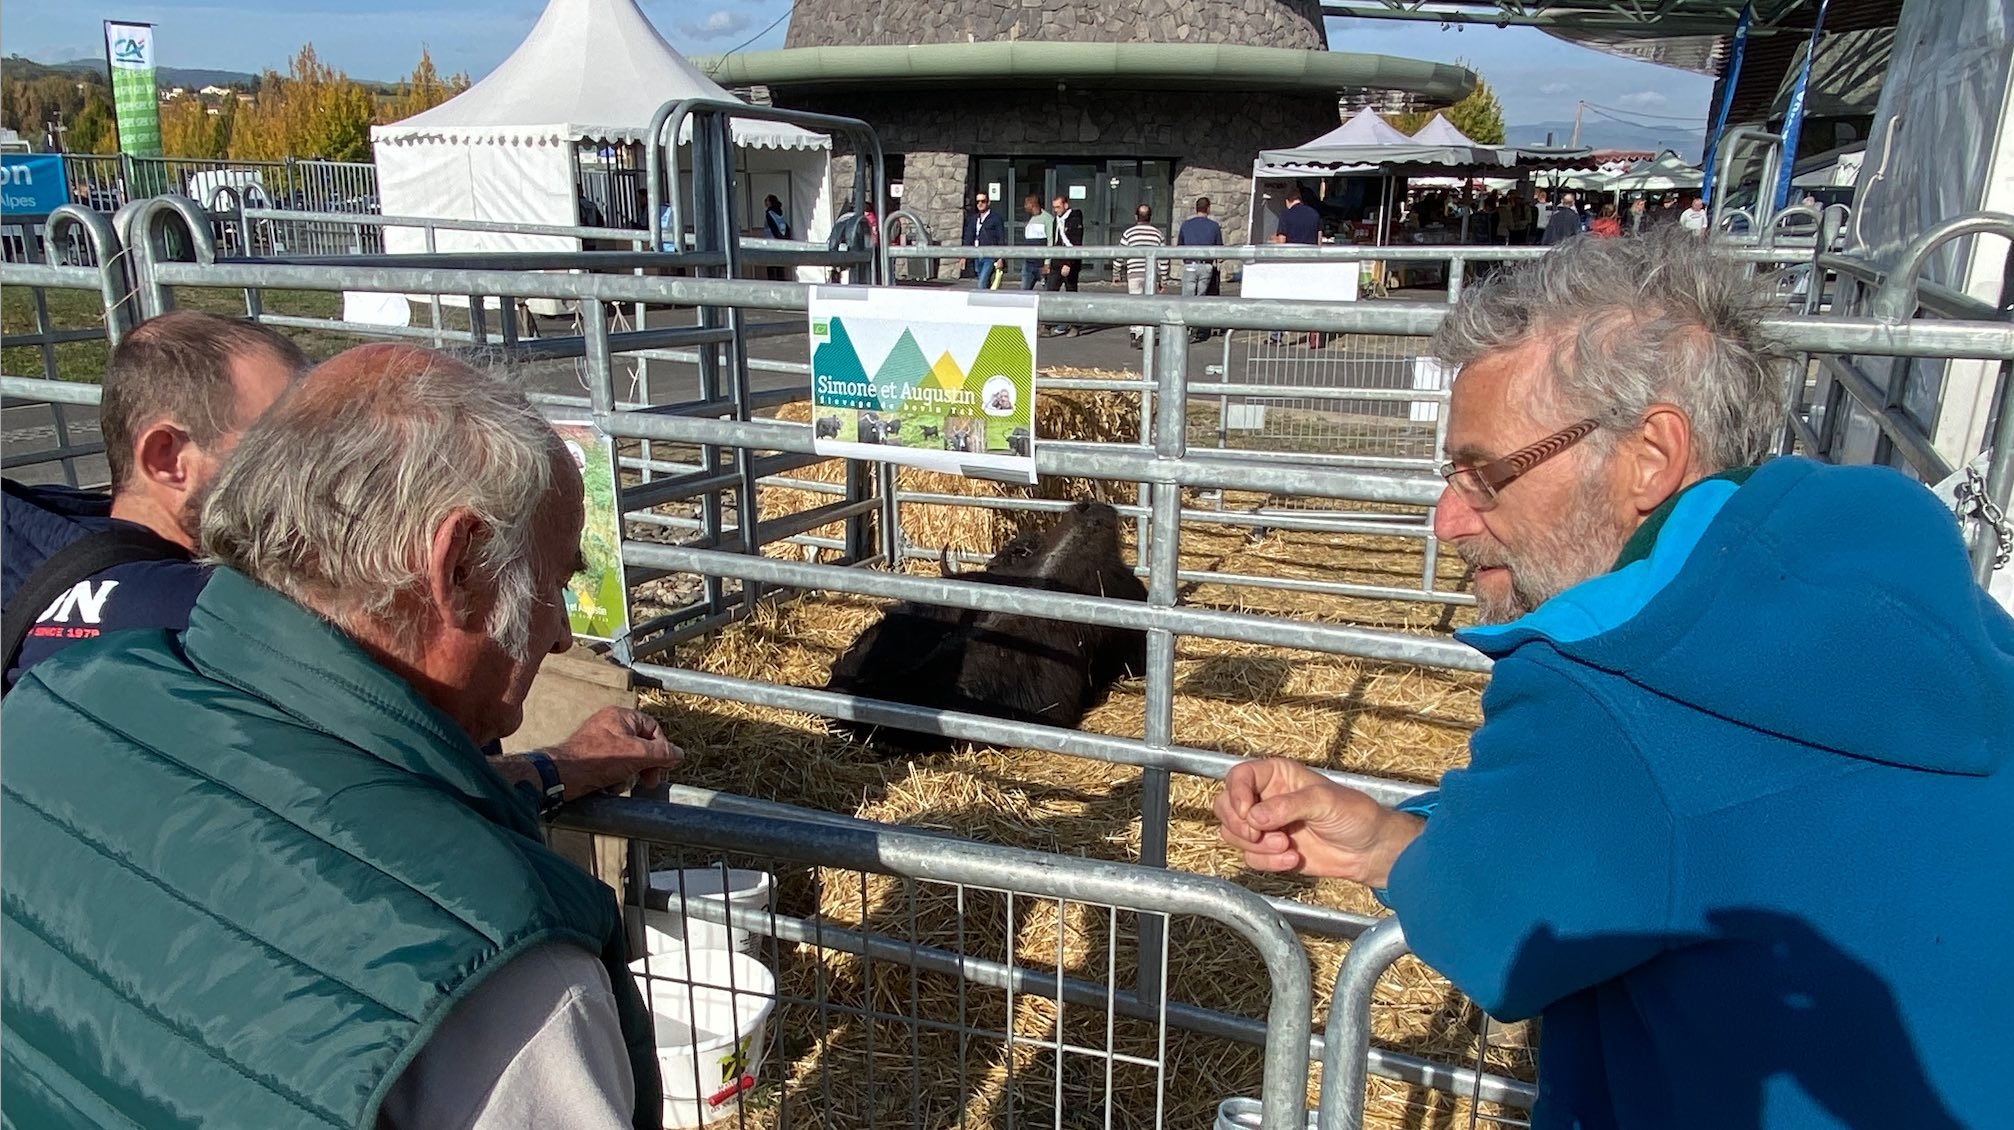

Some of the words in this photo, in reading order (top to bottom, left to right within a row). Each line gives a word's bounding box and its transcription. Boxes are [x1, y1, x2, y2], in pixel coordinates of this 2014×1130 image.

[817, 374, 877, 398] Simone
[880, 382, 898, 399] et
[901, 381, 976, 406] Augustin
[903, 401, 942, 413] bovin
[34, 626, 65, 638] SINCE
